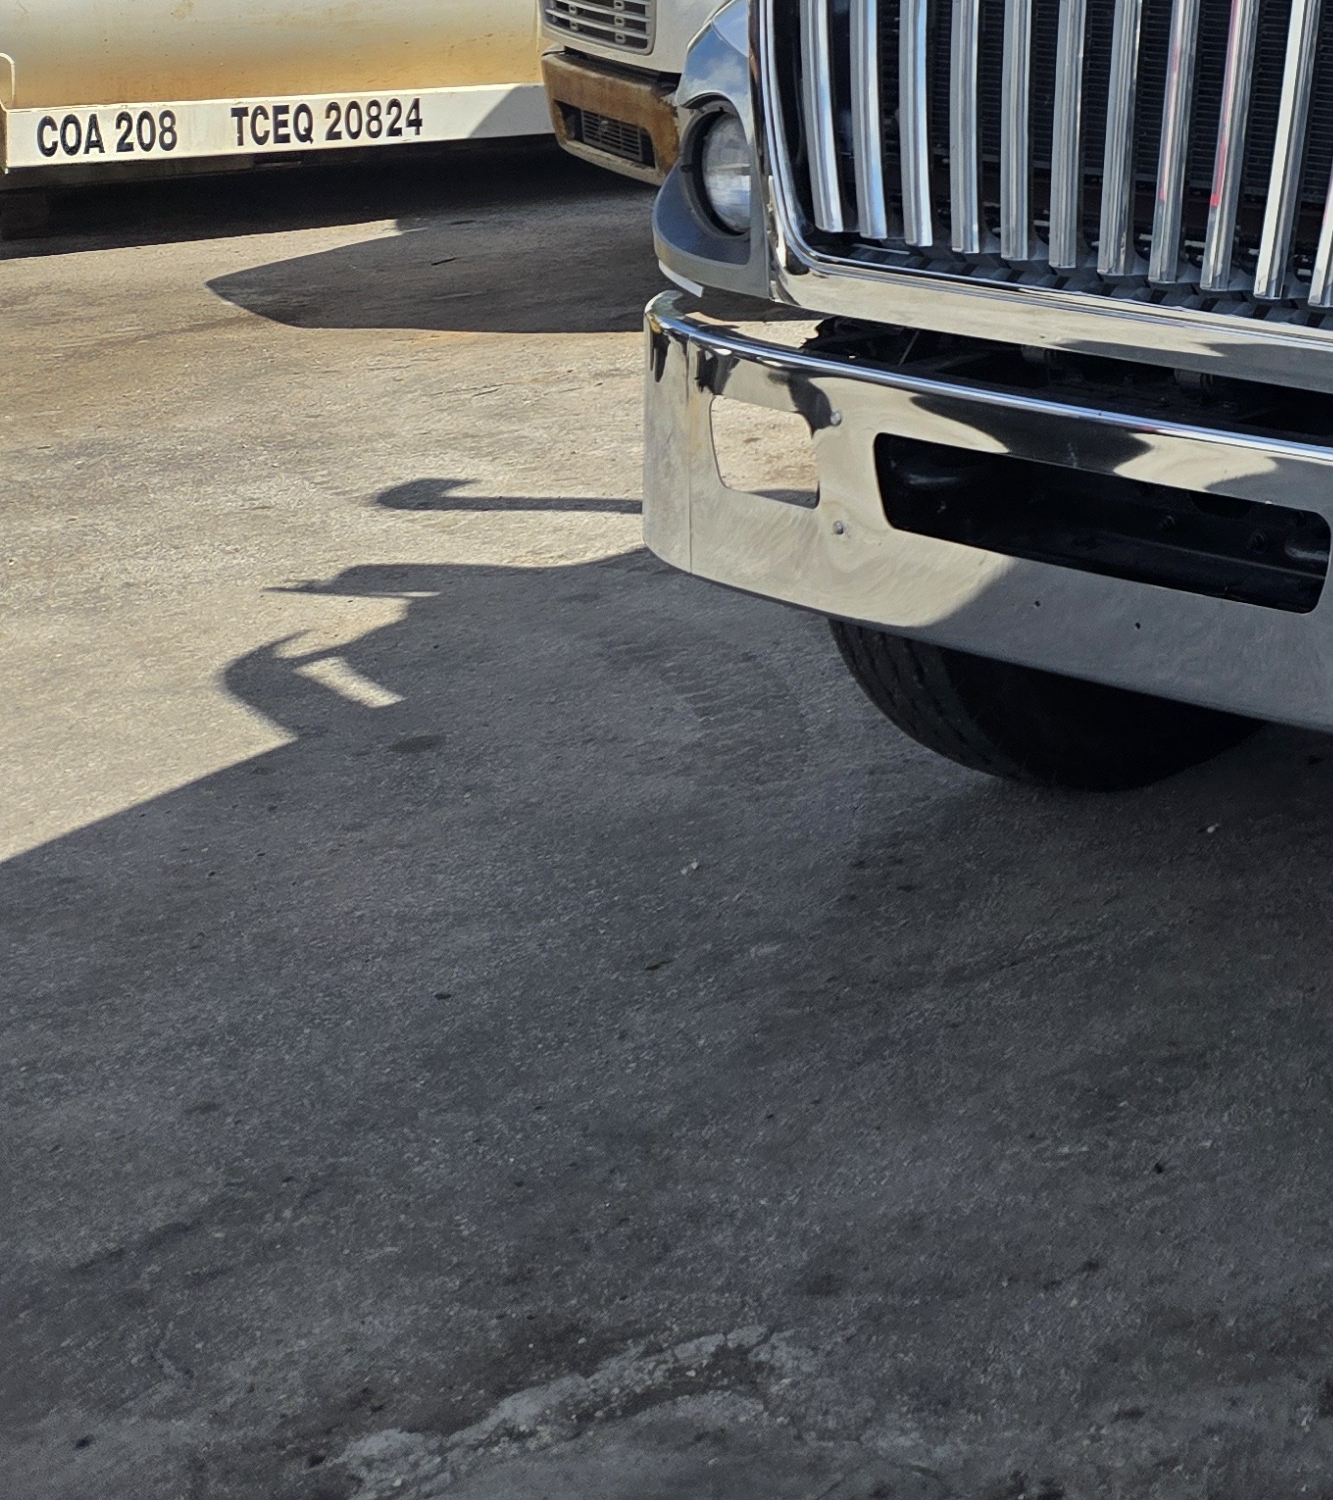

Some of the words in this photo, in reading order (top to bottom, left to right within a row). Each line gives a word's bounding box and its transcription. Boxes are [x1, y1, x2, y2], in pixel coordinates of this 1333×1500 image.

[36, 113, 105, 158] COA
[115, 109, 178, 154] 208
[231, 102, 314, 147] TCEQ
[324, 97, 424, 141] 20824
